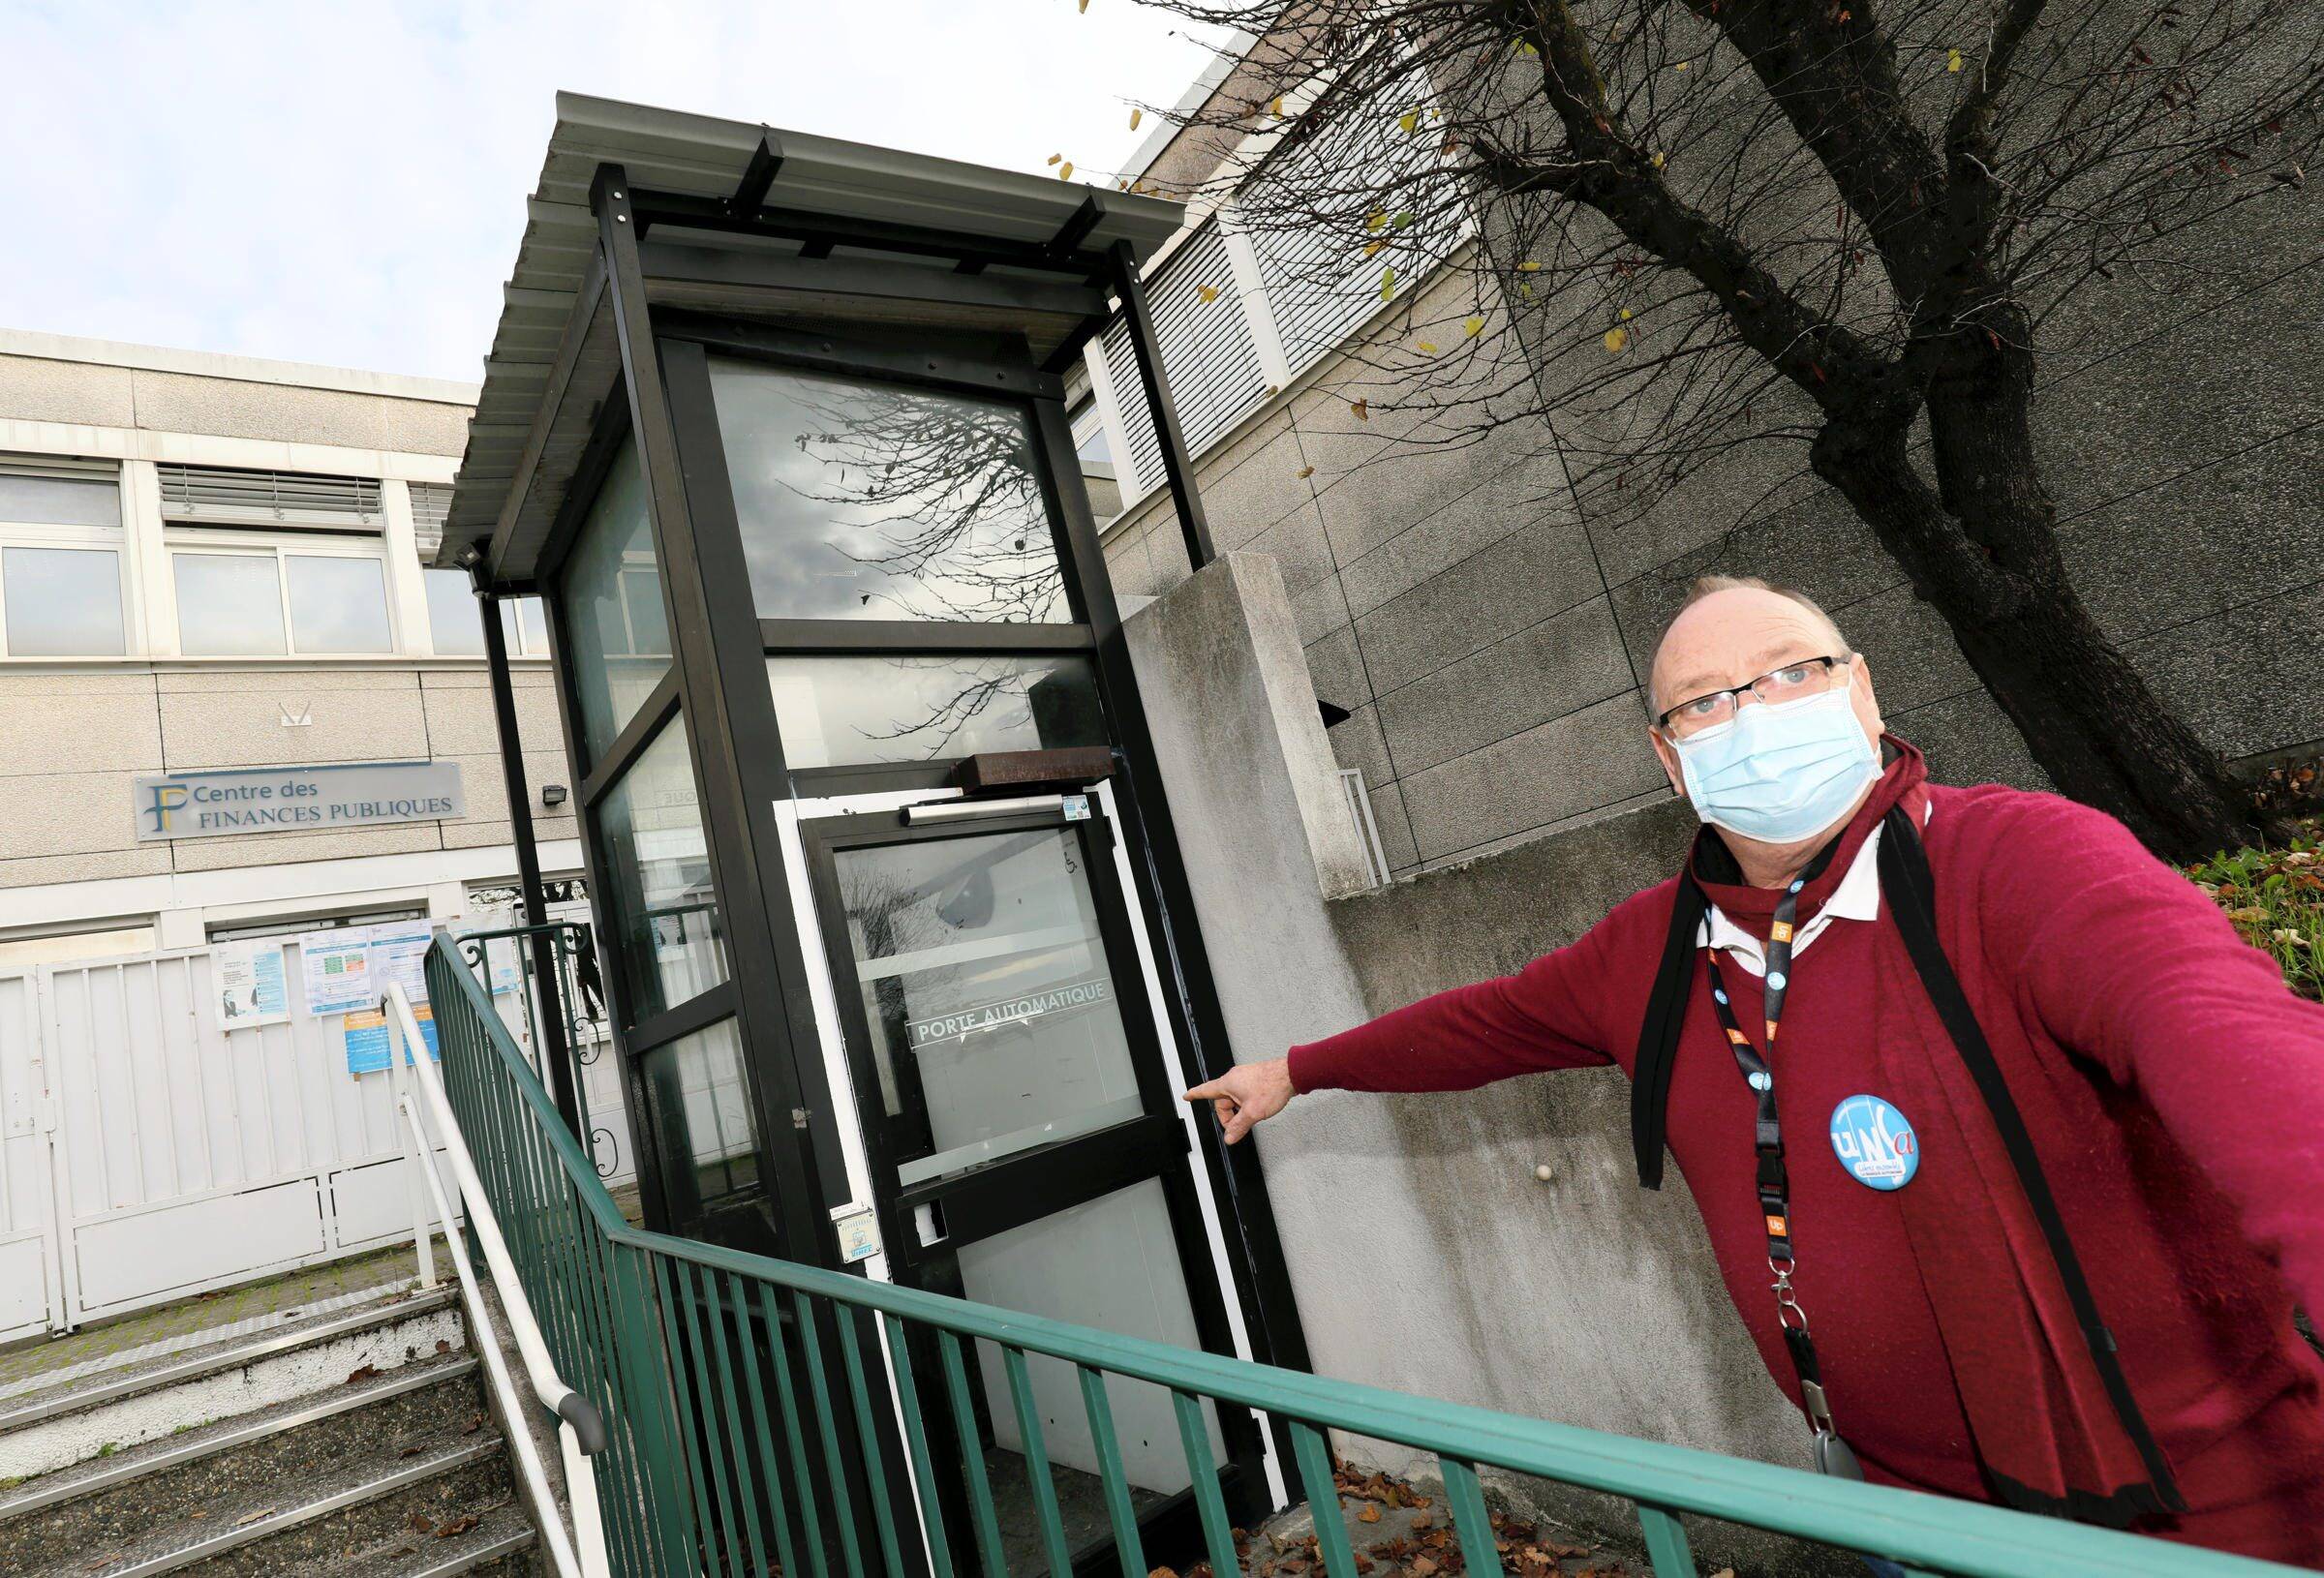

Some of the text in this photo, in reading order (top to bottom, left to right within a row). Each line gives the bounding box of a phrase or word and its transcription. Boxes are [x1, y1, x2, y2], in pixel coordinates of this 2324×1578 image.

[194, 780, 318, 803] Centre des
[199, 797, 453, 830] FINANCES PUBLIQUES
[918, 982, 1105, 1042] PORTE AUTOMATIQUE
